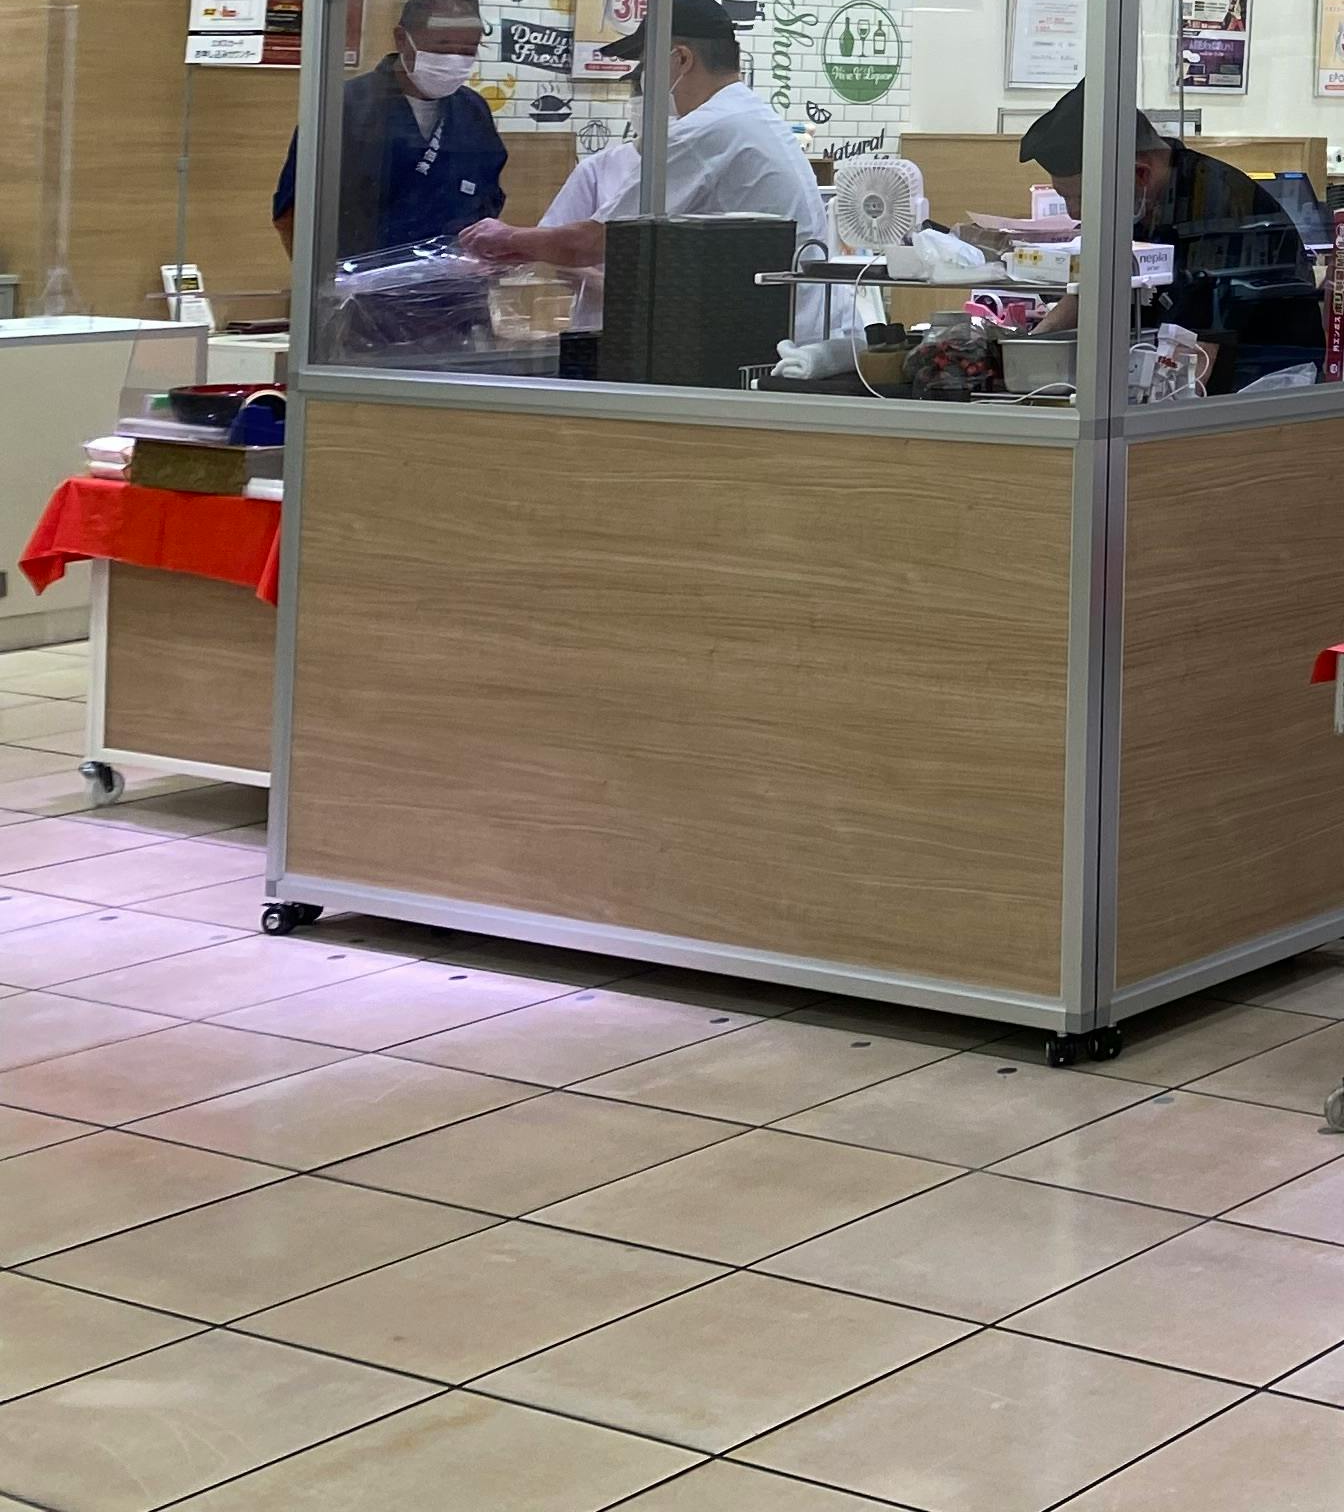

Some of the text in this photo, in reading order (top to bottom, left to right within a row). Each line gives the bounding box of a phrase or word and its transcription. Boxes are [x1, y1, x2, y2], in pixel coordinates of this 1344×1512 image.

[511, 24, 569, 54] Daily
[511, 43, 571, 67] Fresh
[823, 128, 886, 161] Natural
[1140, 251, 1168, 264] nepia
